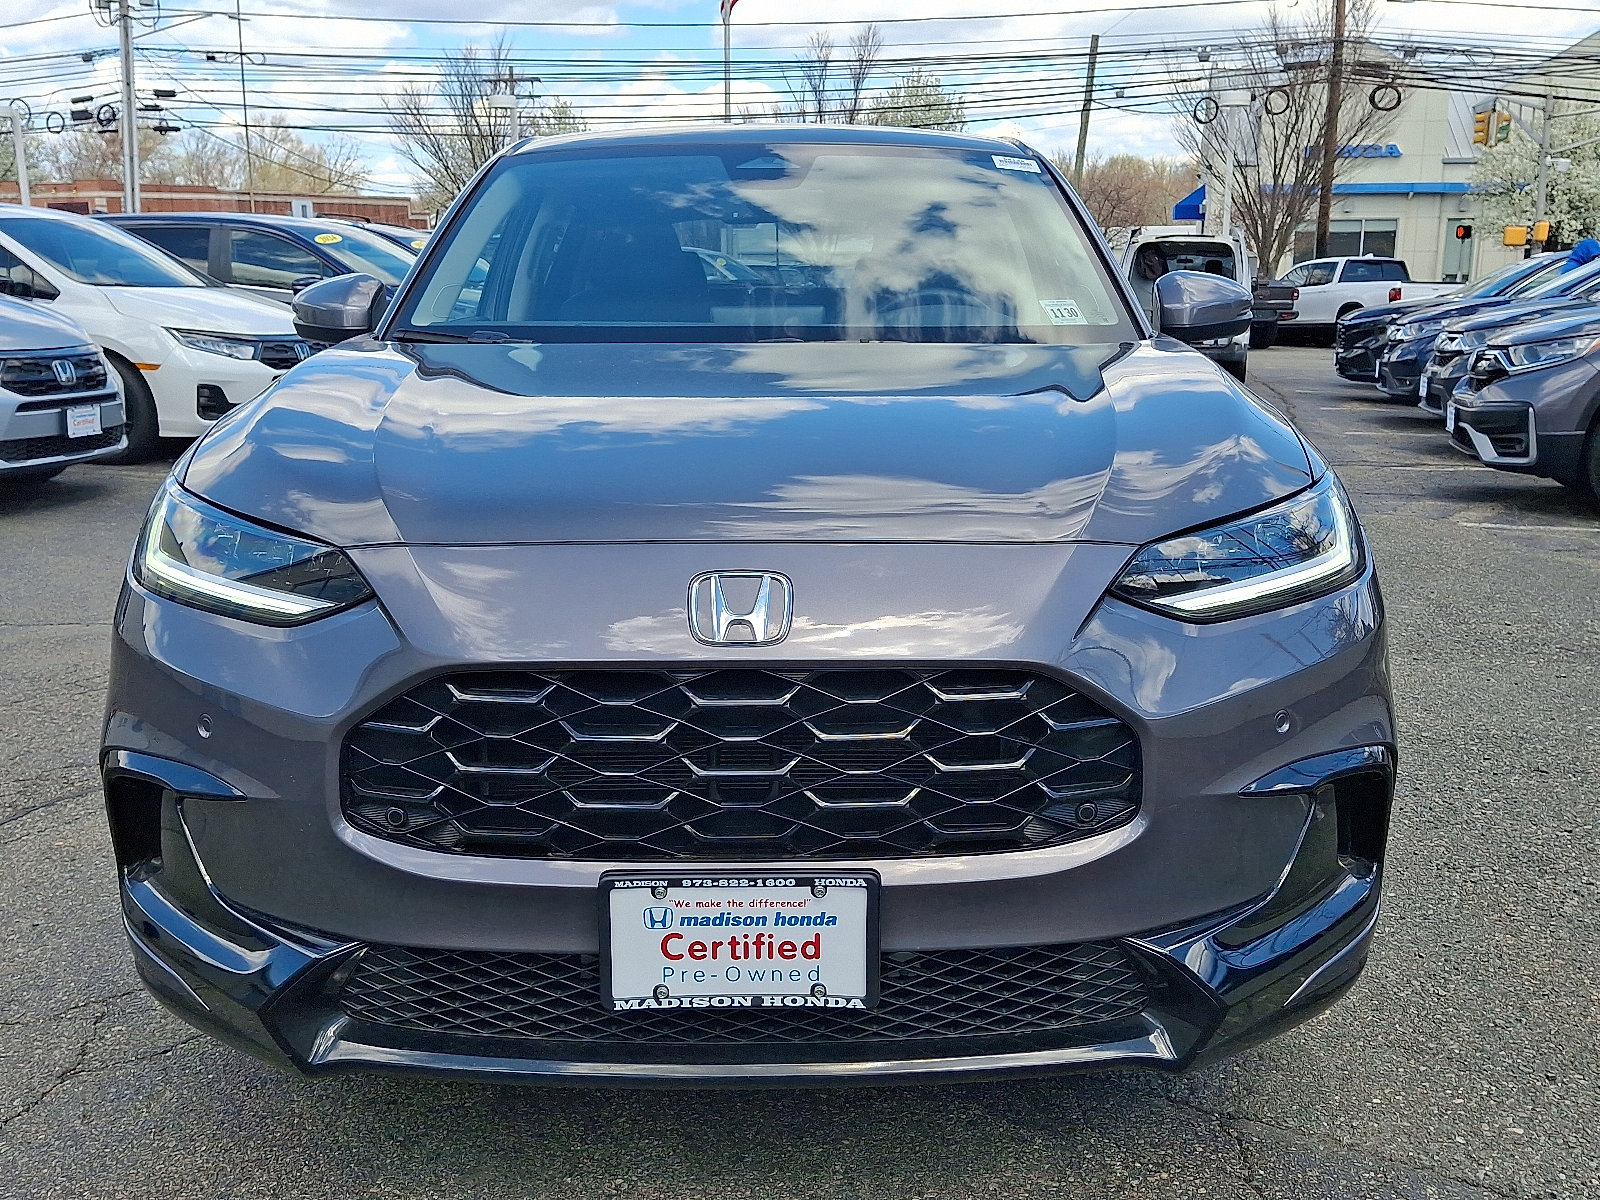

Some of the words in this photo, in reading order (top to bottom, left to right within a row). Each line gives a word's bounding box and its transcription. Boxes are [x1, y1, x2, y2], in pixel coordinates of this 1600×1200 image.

[682, 879, 796, 887] 973-822-1600
[696, 899, 722, 908] make
[727, 899, 744, 908] the
[680, 912, 767, 926] madison
[774, 912, 837, 926] honda
[661, 933, 820, 960] Certified
[663, 965, 819, 982] Pre-Owned
[614, 996, 753, 1010] MADISON
[762, 996, 866, 1009] HONDA
